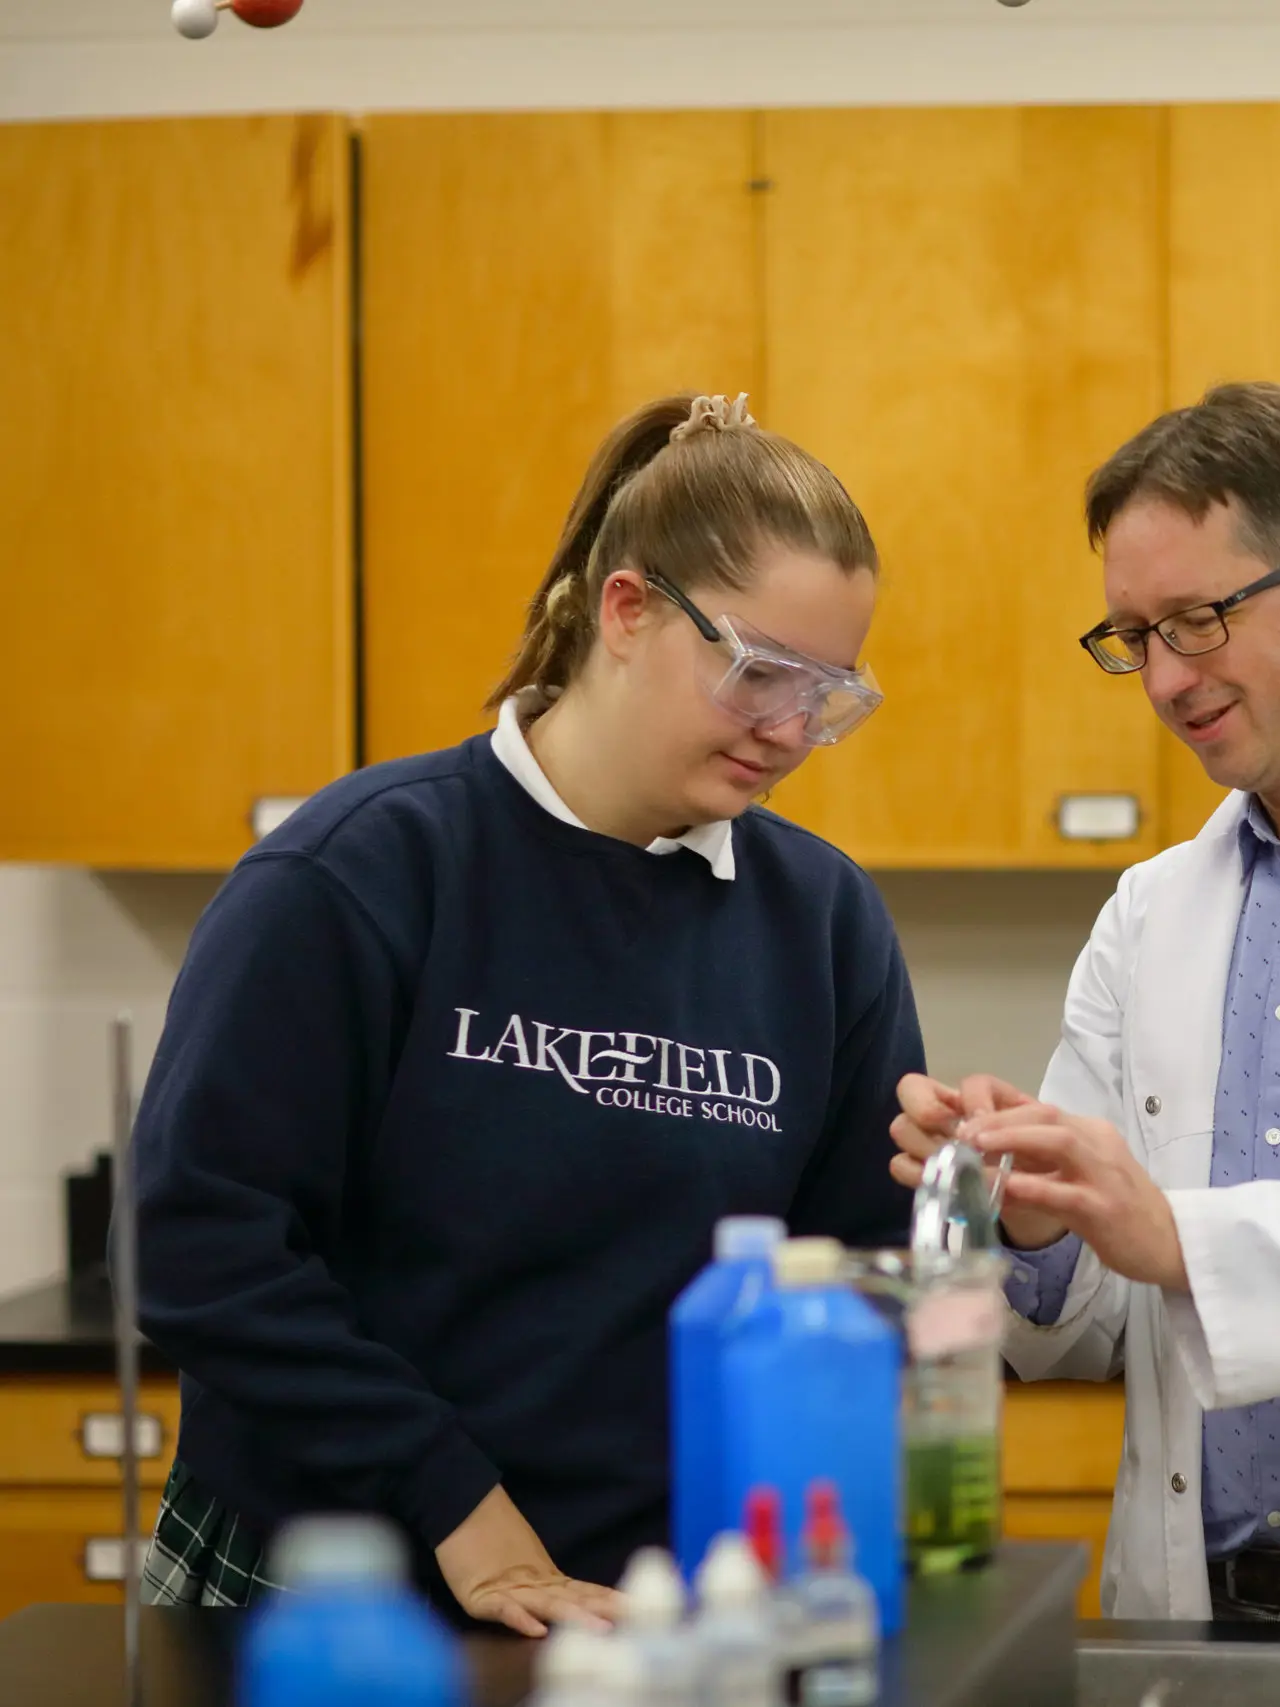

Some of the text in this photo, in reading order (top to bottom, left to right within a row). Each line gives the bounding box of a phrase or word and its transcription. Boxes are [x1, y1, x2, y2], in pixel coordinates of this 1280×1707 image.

[446, 1007, 781, 1106] LAKEFIELD
[596, 1087, 783, 1132] COLLEGE SCHOOL
